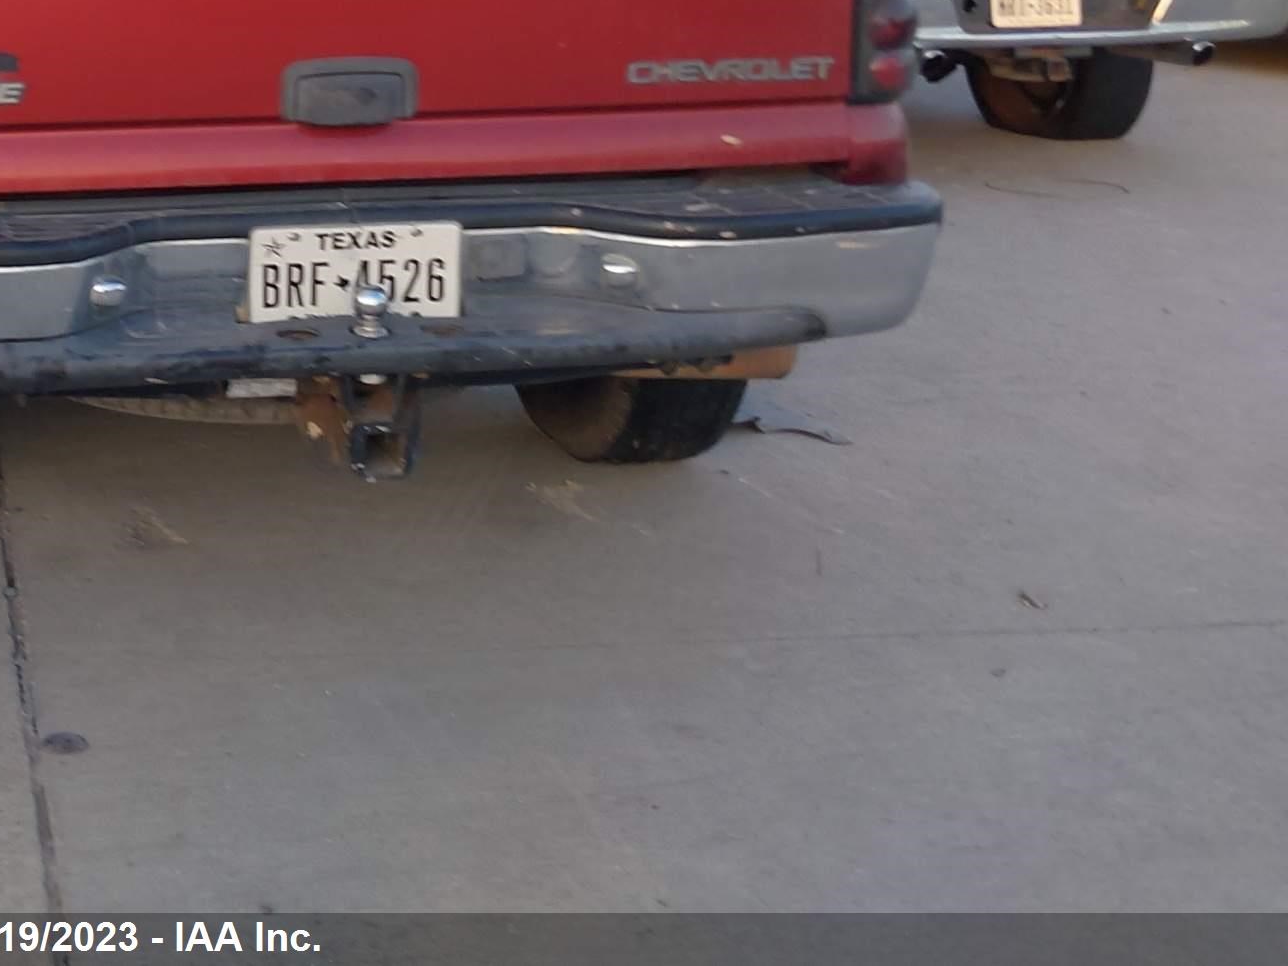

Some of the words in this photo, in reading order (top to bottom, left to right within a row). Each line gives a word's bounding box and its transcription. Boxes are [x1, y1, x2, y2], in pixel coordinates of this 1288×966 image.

[626, 55, 836, 84] CHEVROLET
[315, 230, 398, 250] TEXAS
[262, 261, 331, 308] BRF
[353, 257, 447, 304] 4526
